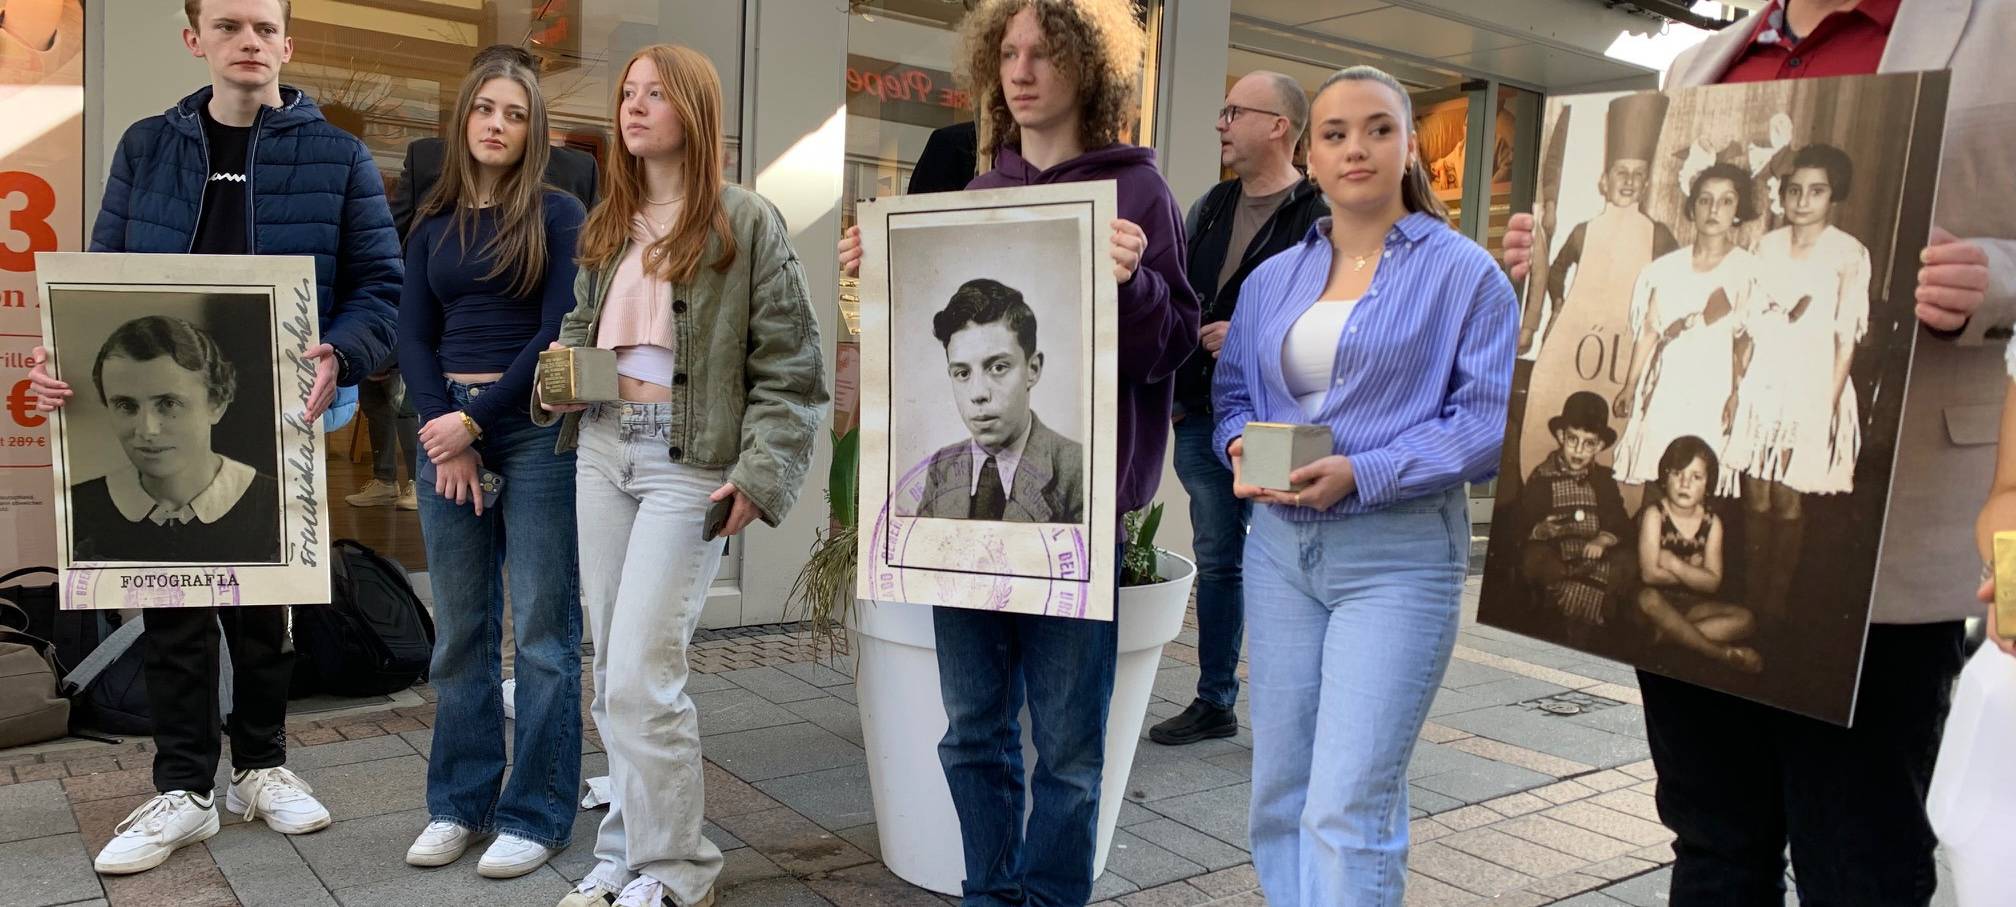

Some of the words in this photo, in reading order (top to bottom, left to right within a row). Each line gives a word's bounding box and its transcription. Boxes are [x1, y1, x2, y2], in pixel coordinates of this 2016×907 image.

[6, 378, 47, 428] €
[8, 437, 33, 447] 289
[38, 437, 46, 447] €
[120, 574, 240, 589] FOTOGRAFIA
